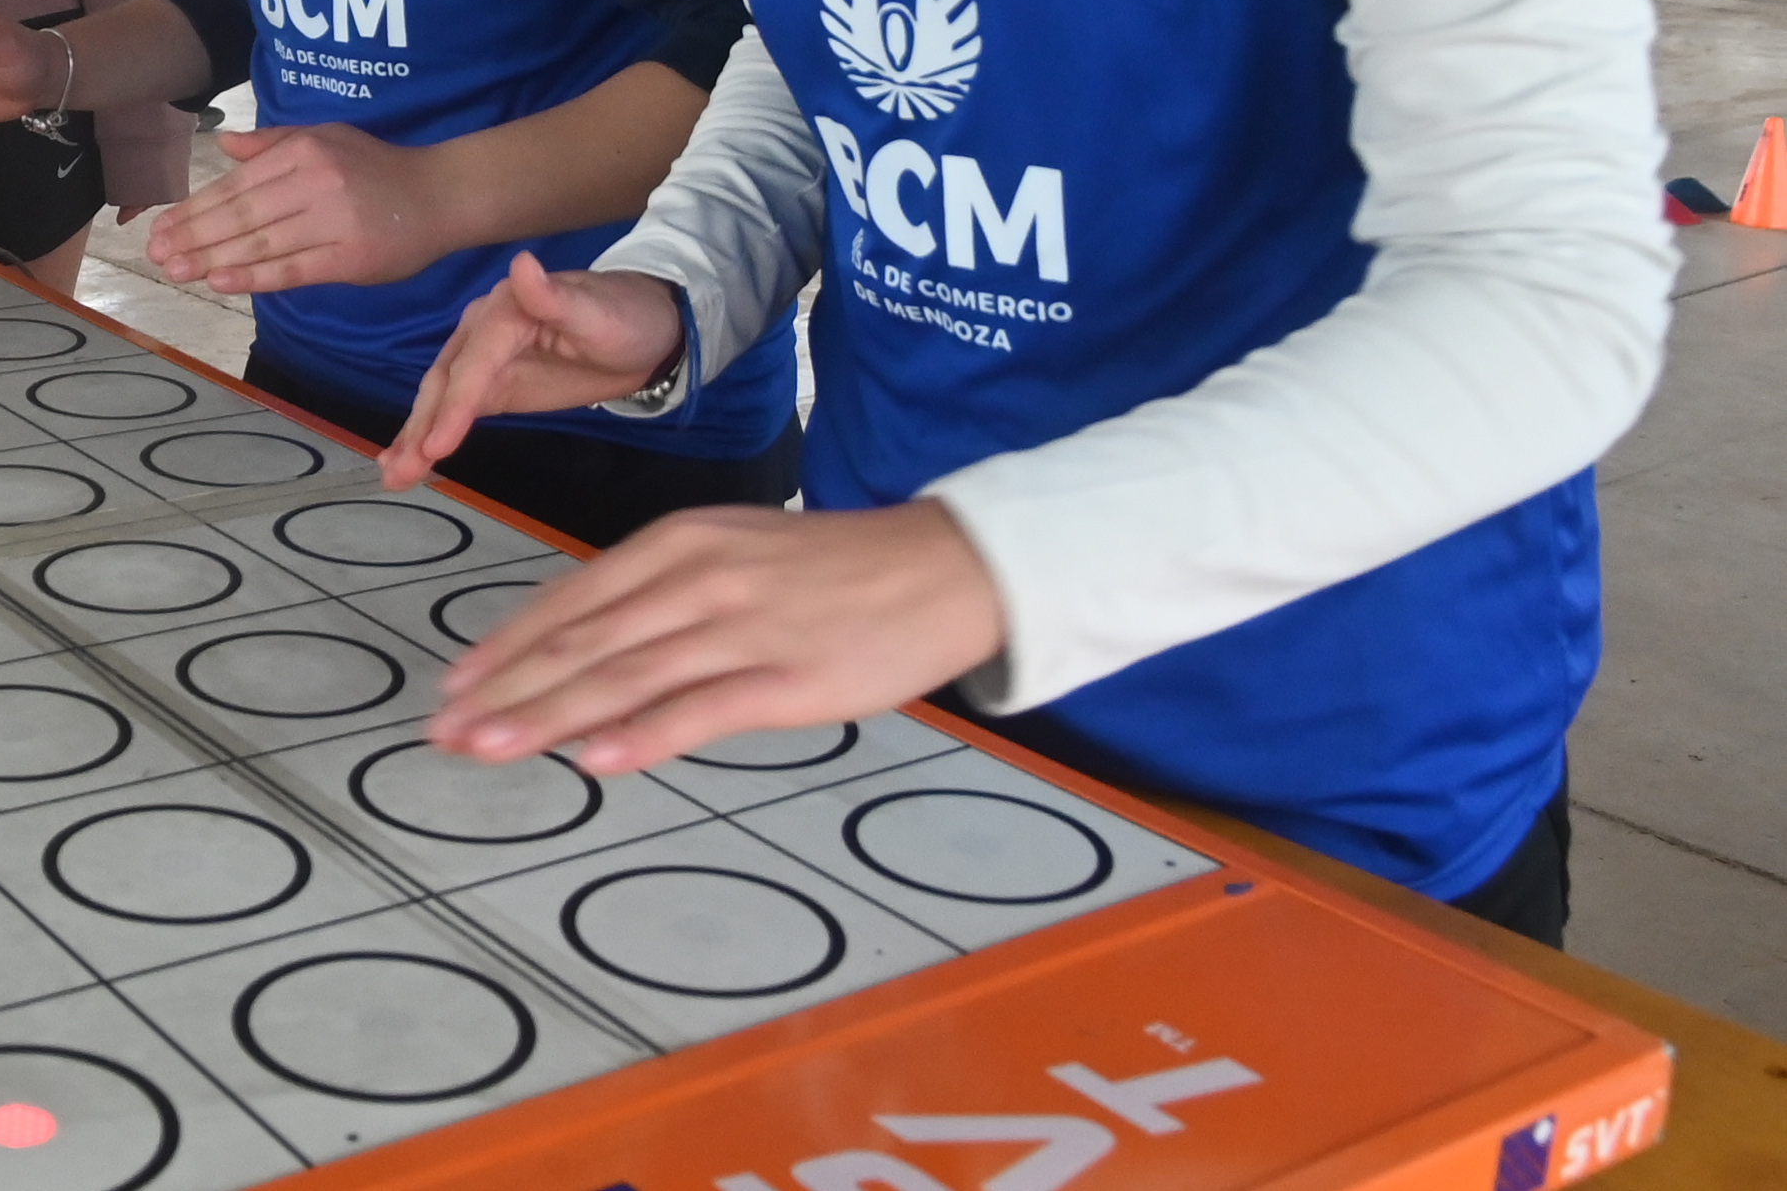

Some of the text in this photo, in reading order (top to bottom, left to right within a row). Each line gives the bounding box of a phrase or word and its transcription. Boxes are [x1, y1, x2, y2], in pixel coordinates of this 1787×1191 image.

[281, 68, 372, 99] DE MENDOZA
[296, 49, 317, 66] DE
[319, 53, 410, 77] COMERCIO
[814, 115, 1069, 283] BCM
[853, 280, 1012, 352] DE MENDOZA
[884, 264, 1073, 323] DE COMERCIO
[1560, 1096, 1653, 1180] SVT
